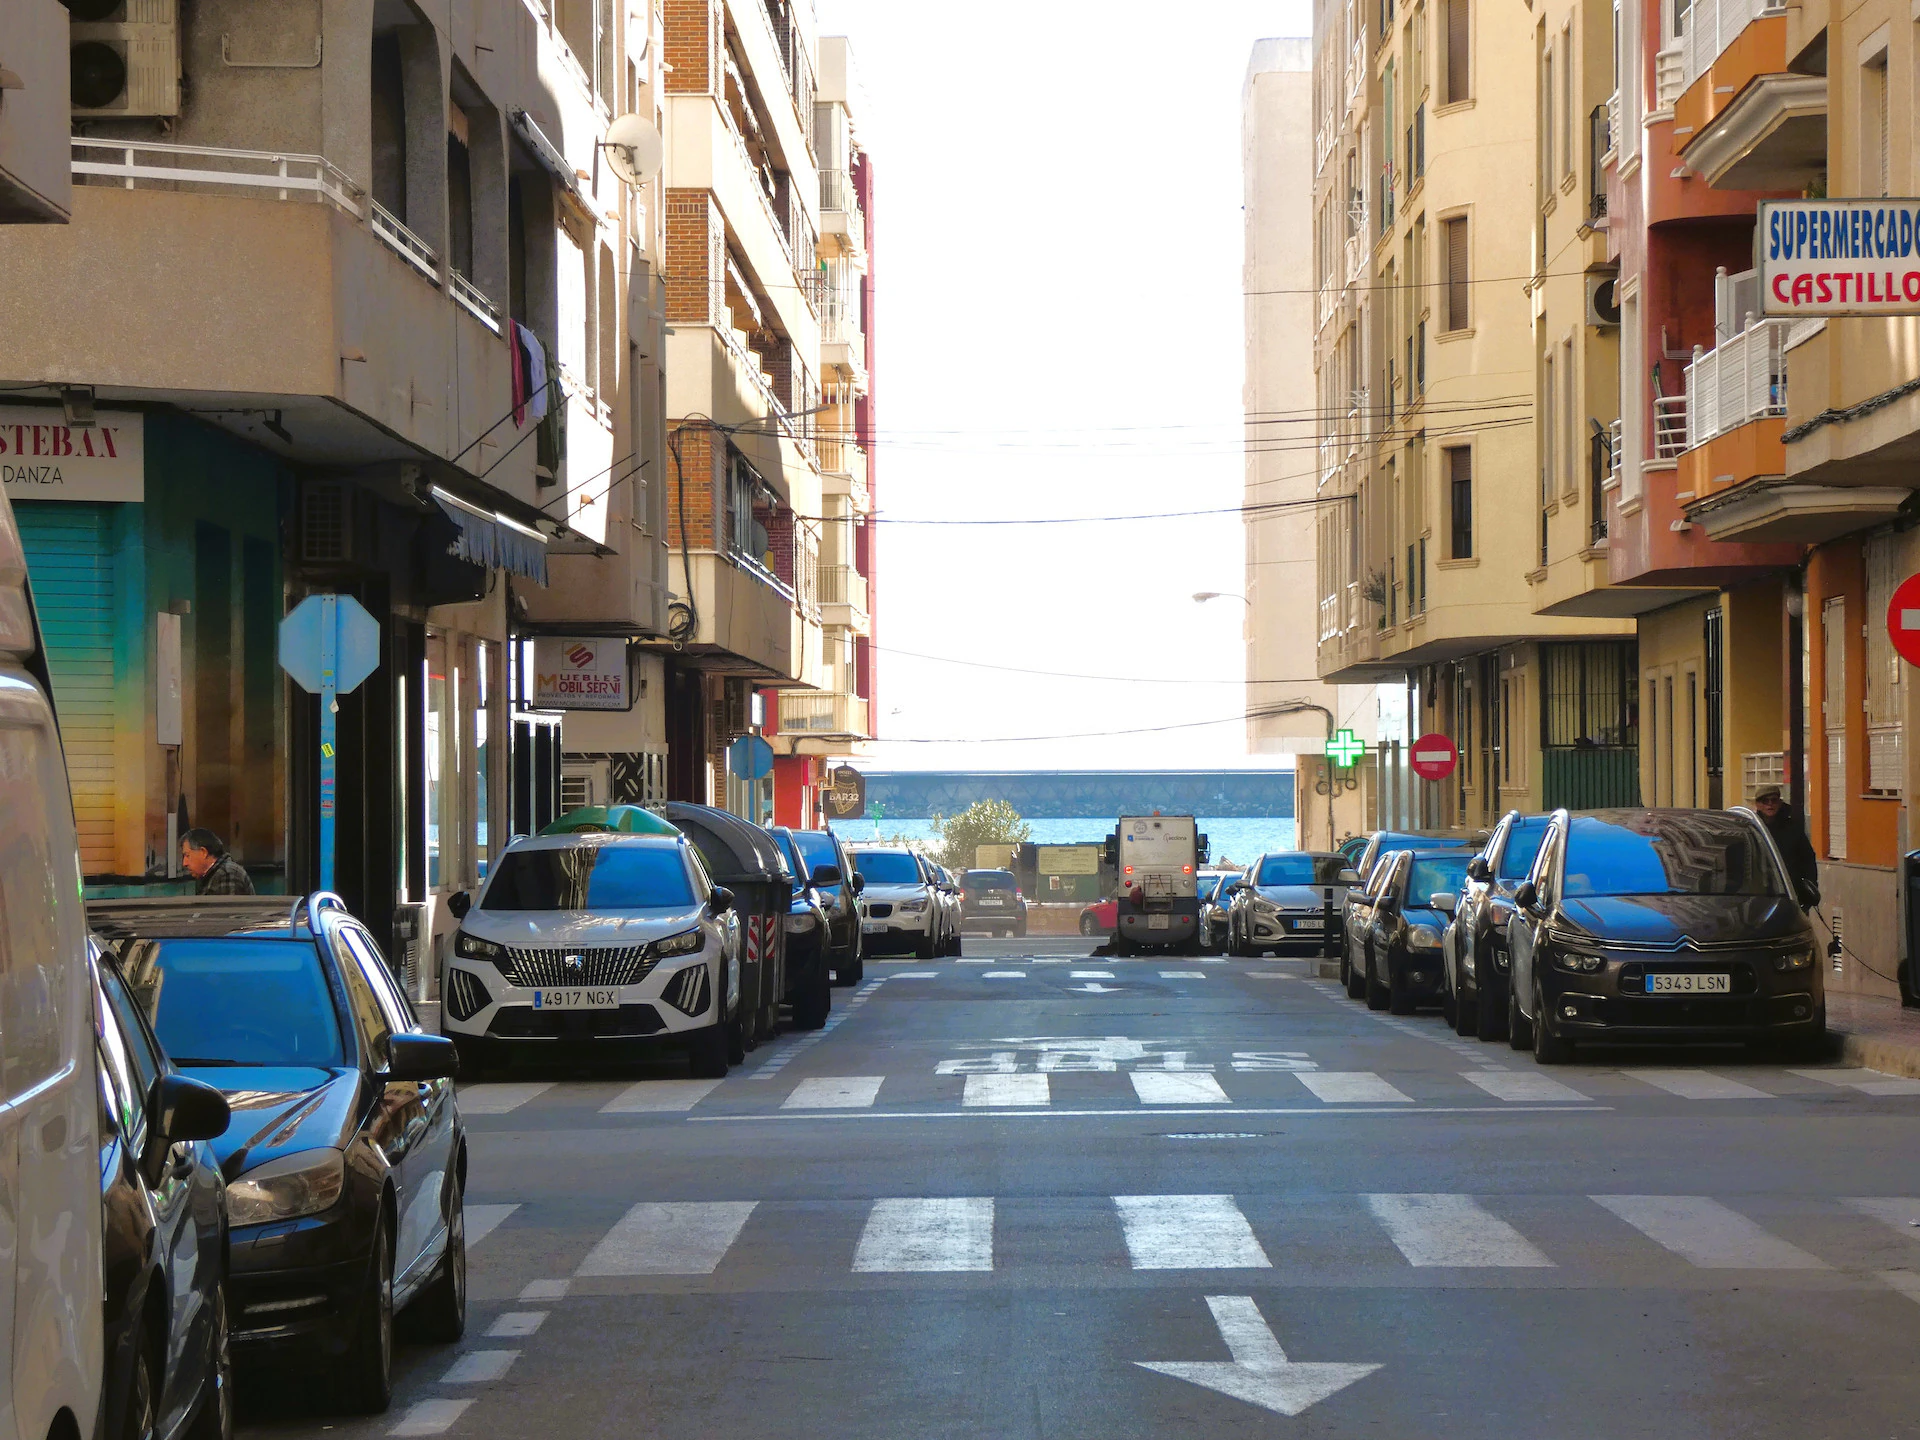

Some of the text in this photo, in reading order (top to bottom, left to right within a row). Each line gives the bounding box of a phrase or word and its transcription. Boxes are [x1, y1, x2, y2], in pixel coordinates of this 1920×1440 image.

[1772, 271, 1920, 306] CASTILLO
[3, 465, 64, 484] DANZA
[1655, 975, 1726, 990] 5343 LSN
[544, 990, 615, 1006] 4917 NGX
